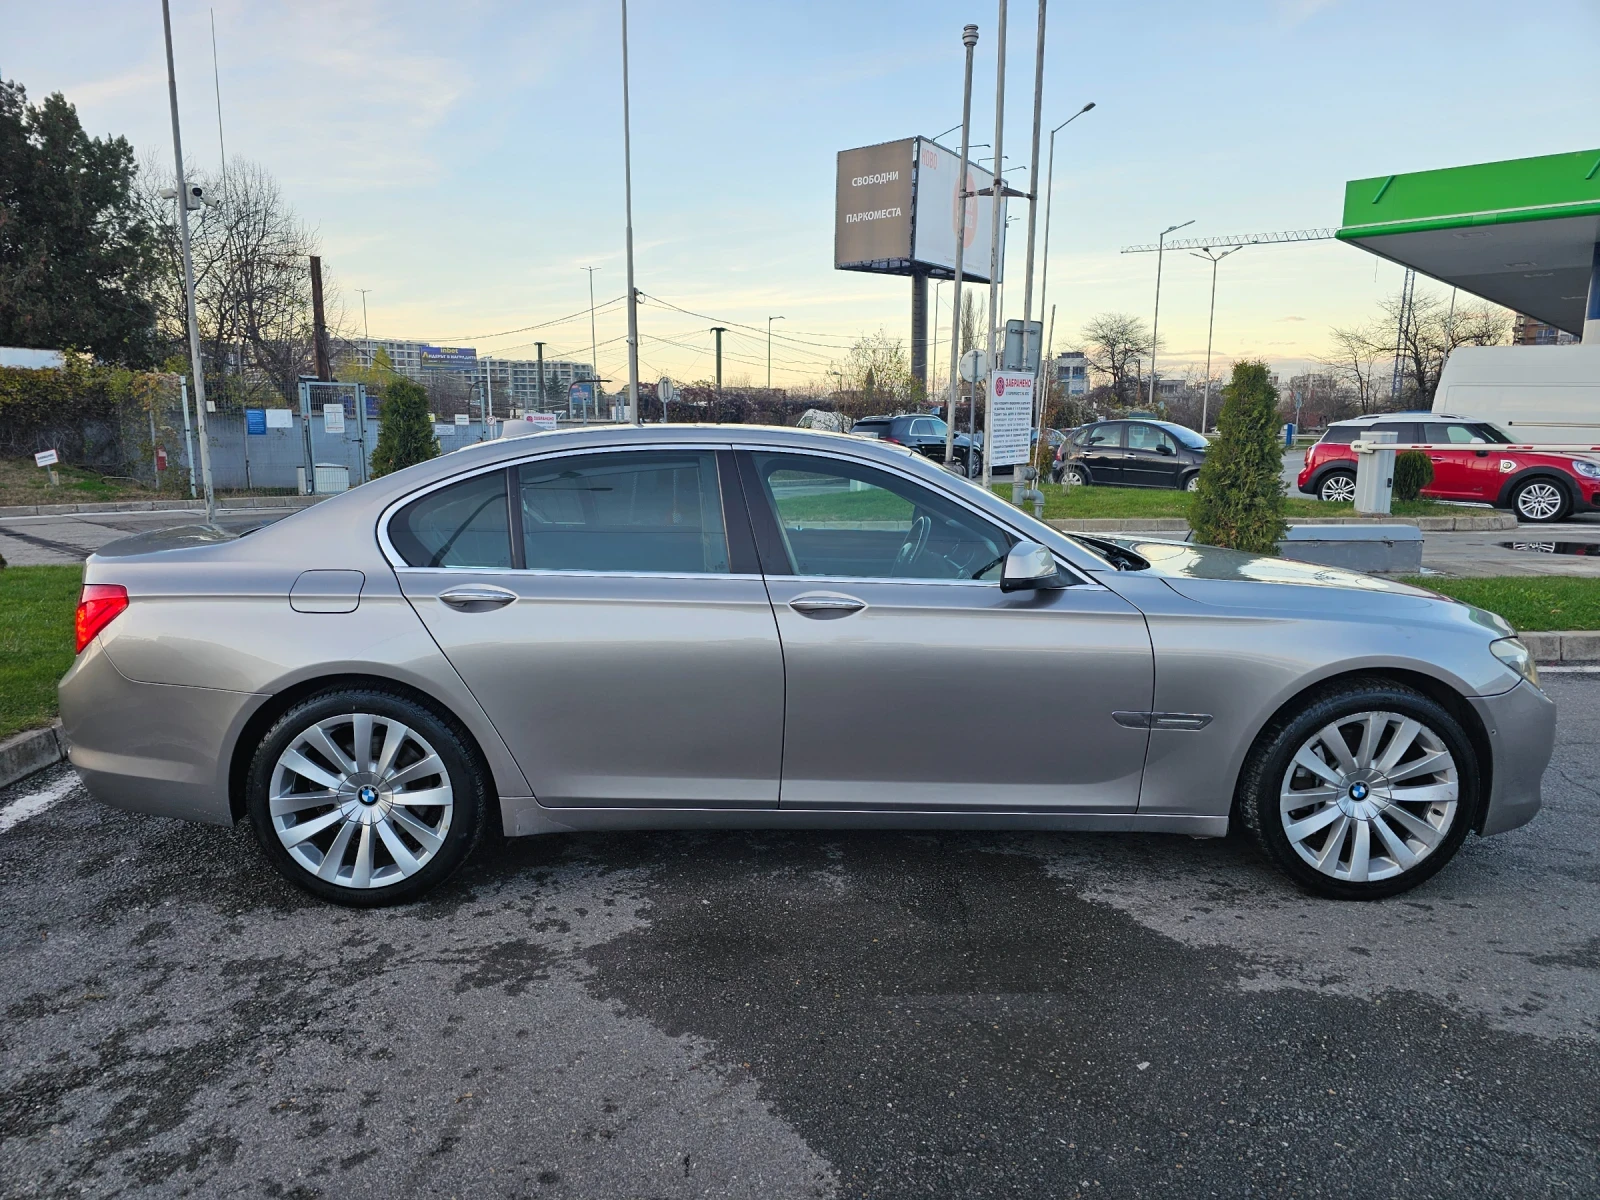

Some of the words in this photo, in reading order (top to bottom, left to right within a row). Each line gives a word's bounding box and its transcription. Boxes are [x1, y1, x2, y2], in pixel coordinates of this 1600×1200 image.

[851, 171, 899, 187] СВОБОДНИ
[846, 207, 902, 223] ПАРКОМЕСТА
[1005, 378, 1032, 388] ЗАБРАНЕНО
